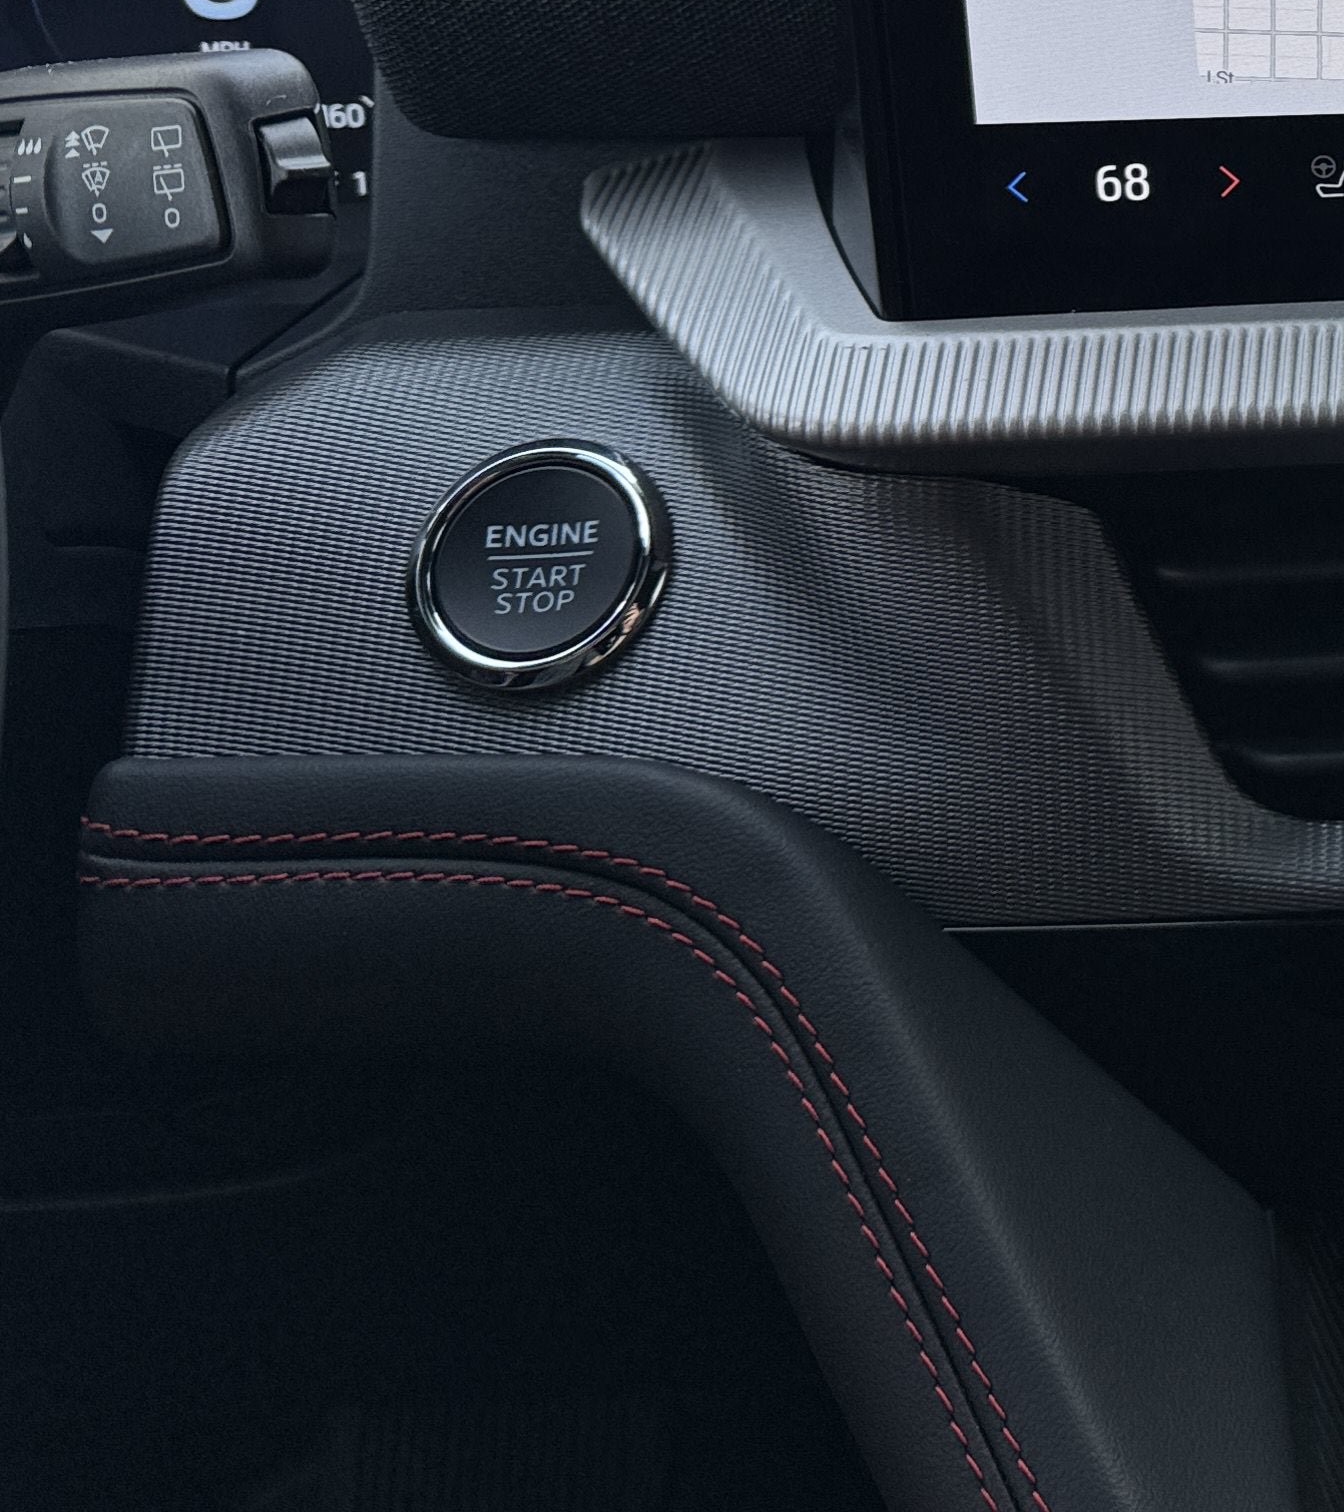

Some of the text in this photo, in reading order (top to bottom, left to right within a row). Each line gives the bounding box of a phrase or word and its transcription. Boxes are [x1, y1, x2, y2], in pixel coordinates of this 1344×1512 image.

[322, 103, 365, 128] 160
[1094, 162, 1151, 204] 68
[485, 520, 600, 548] ENGINE
[491, 564, 586, 590] START
[494, 590, 575, 615] STOP
